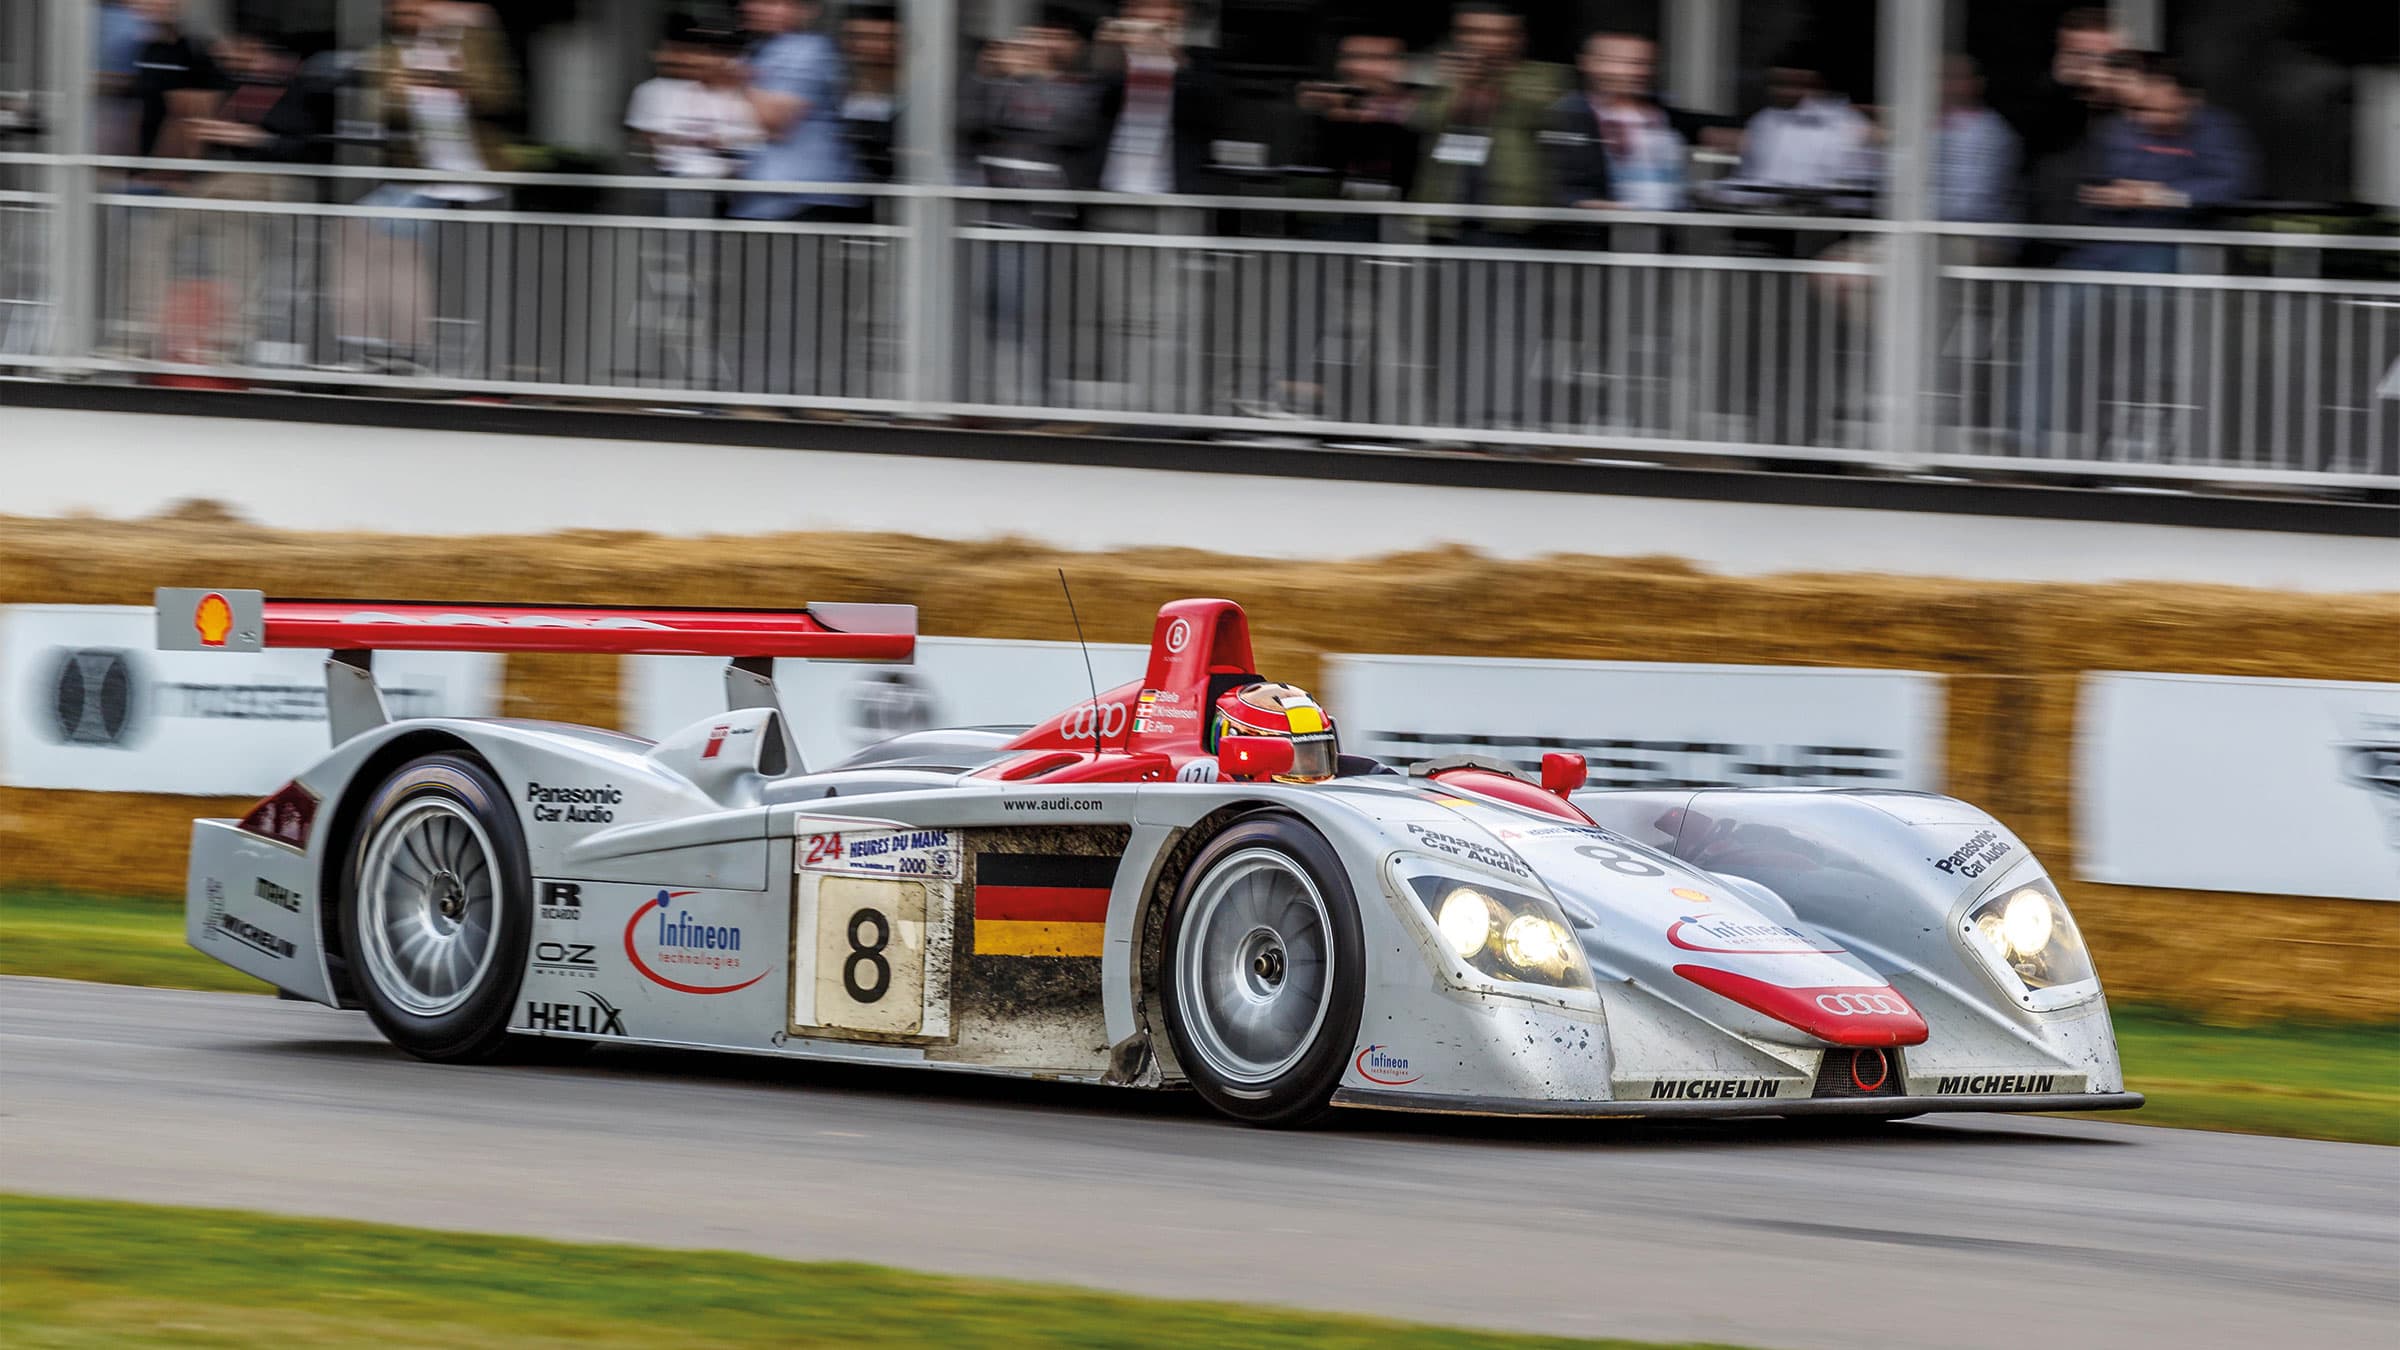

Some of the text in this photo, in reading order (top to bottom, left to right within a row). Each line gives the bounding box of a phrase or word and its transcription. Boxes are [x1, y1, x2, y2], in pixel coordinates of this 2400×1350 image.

[526, 782, 622, 804] Panasonic
[1003, 797, 1103, 811] www.audi.com
[534, 803, 614, 823] Car Audio
[805, 831, 948, 866] 24 HEURES DU MANS
[1420, 837, 1529, 878] Car Audio
[1934, 830, 1998, 875] Panasonic
[1960, 842, 2011, 878] Car Audio
[899, 858, 927, 874] 2000
[1574, 845, 1665, 877] 8
[541, 882, 582, 907] R
[659, 910, 741, 951] Infineon
[1698, 921, 1805, 939] Infineon
[658, 951, 741, 970] technologies
[843, 907, 891, 1004] 8
[527, 991, 630, 1037] HELIX
[1371, 1052, 1409, 1069] Infineon
[1650, 1079, 1780, 1099] MICHELIN
[1936, 1074, 2055, 1094] MICHELIN
